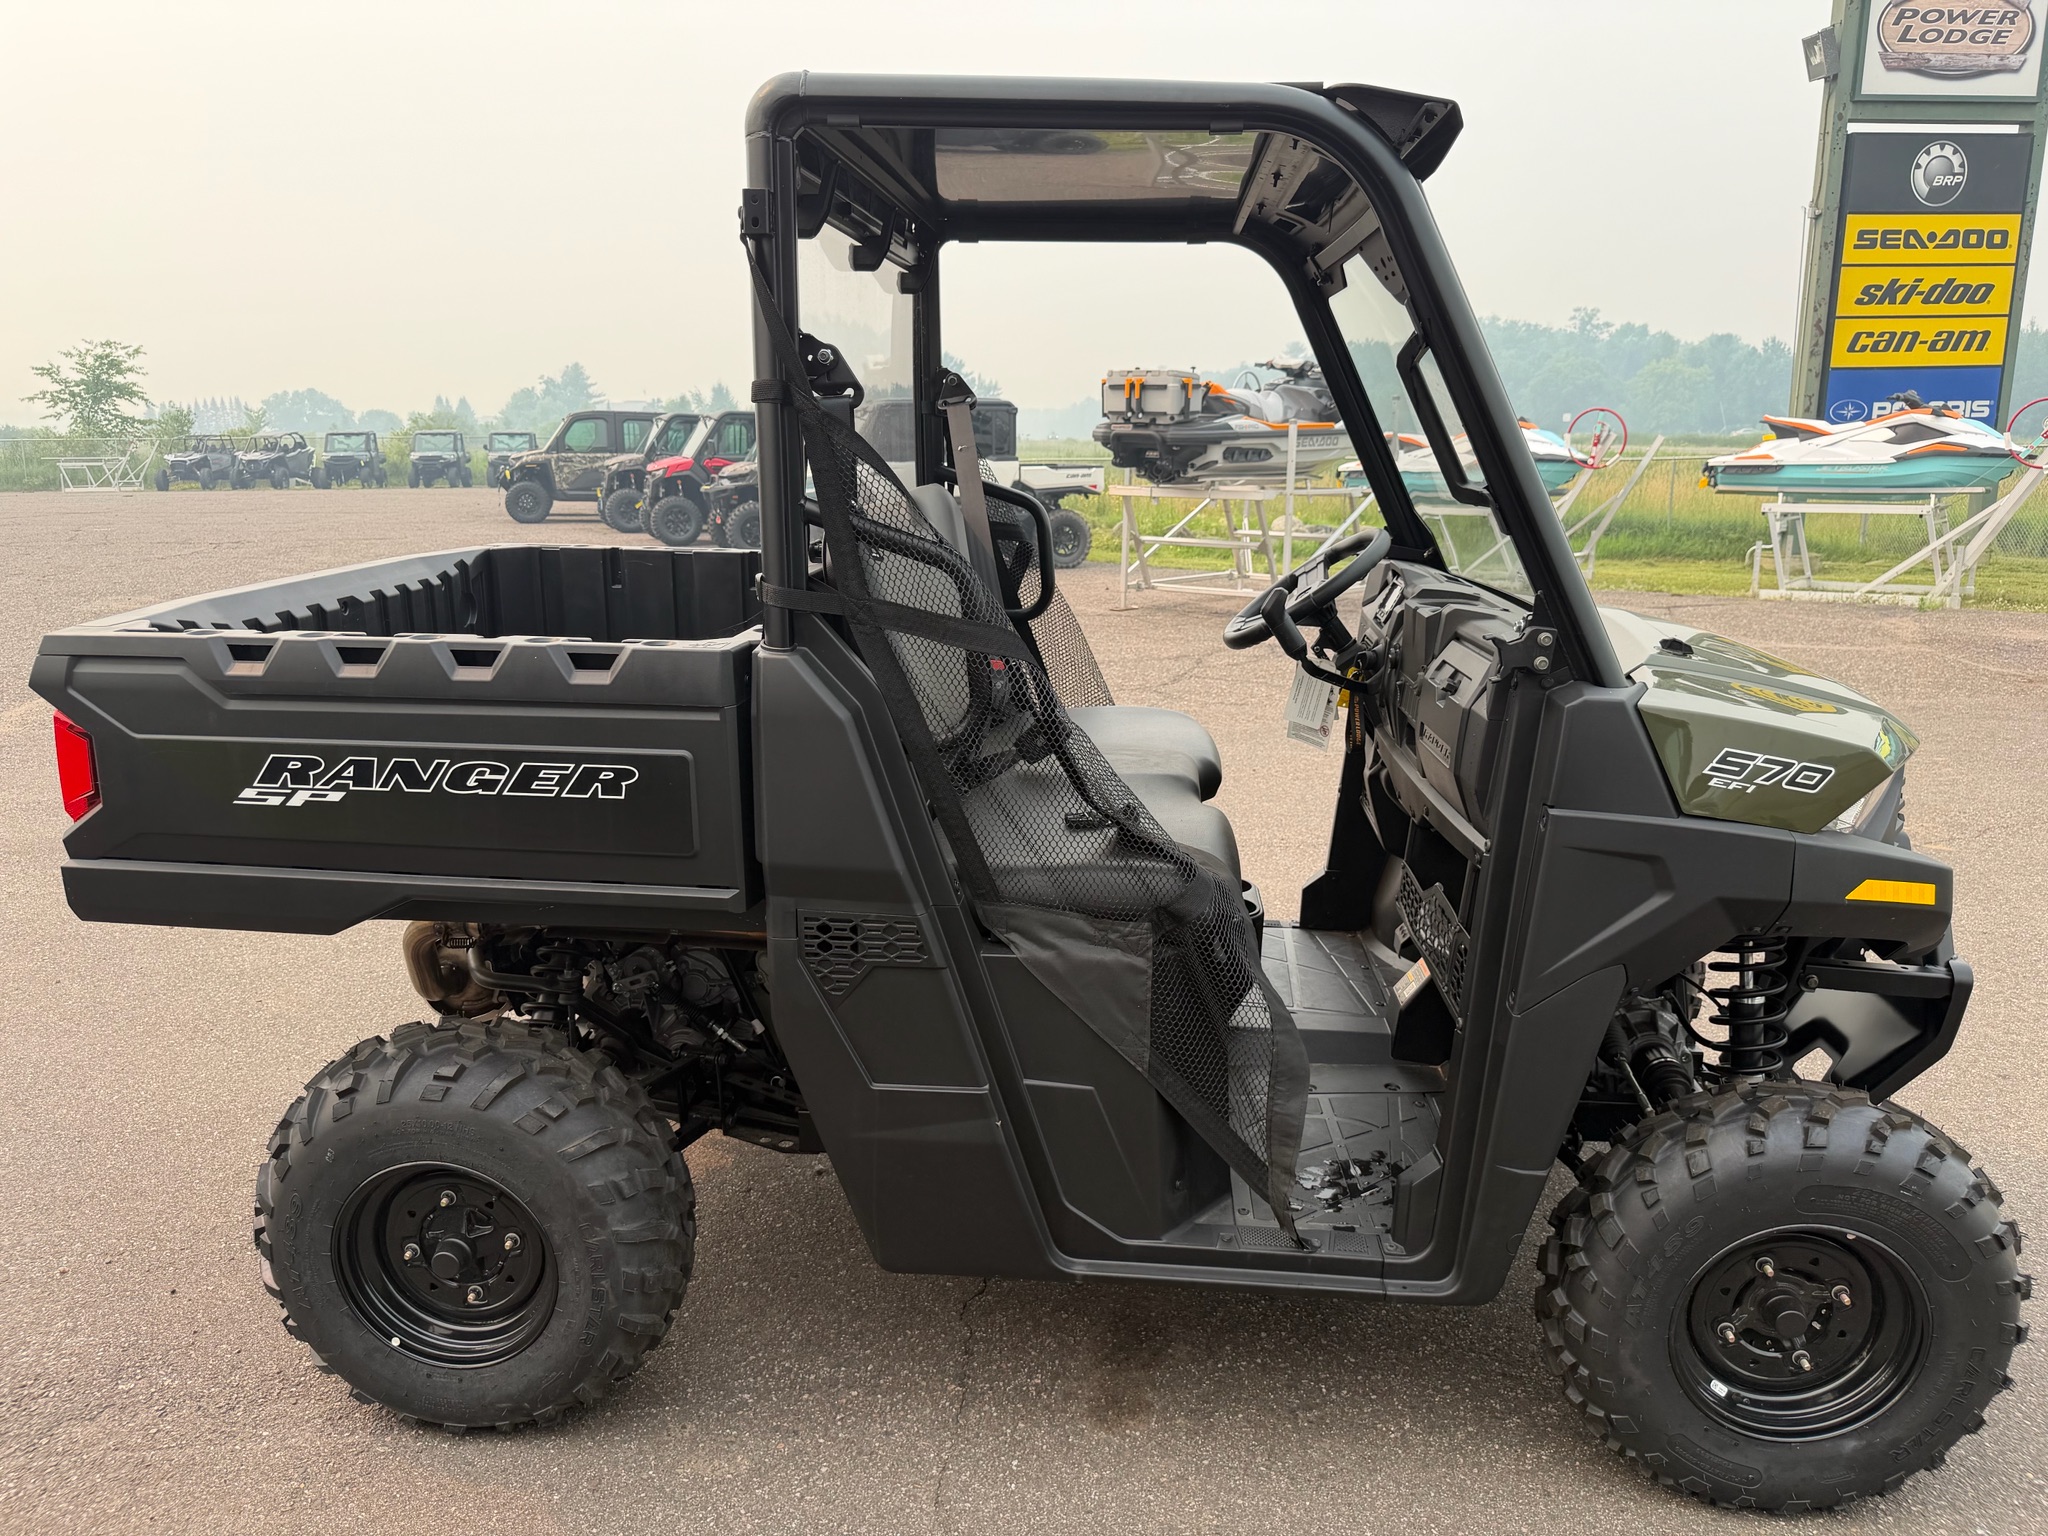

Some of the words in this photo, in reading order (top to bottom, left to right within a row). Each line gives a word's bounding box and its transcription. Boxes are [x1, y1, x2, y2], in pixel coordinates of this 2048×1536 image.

[1891, 8, 2020, 26] POWER
[1896, 25, 2013, 45] LODGE
[1932, 175, 1964, 186] BRP
[1846, 329, 1992, 354] can-am
[1871, 400, 1990, 418] PRIS
[253, 753, 640, 800] RANGER
[1702, 747, 1836, 794] 570
[1708, 777, 1758, 794] EFI
[233, 787, 347, 807] SP
